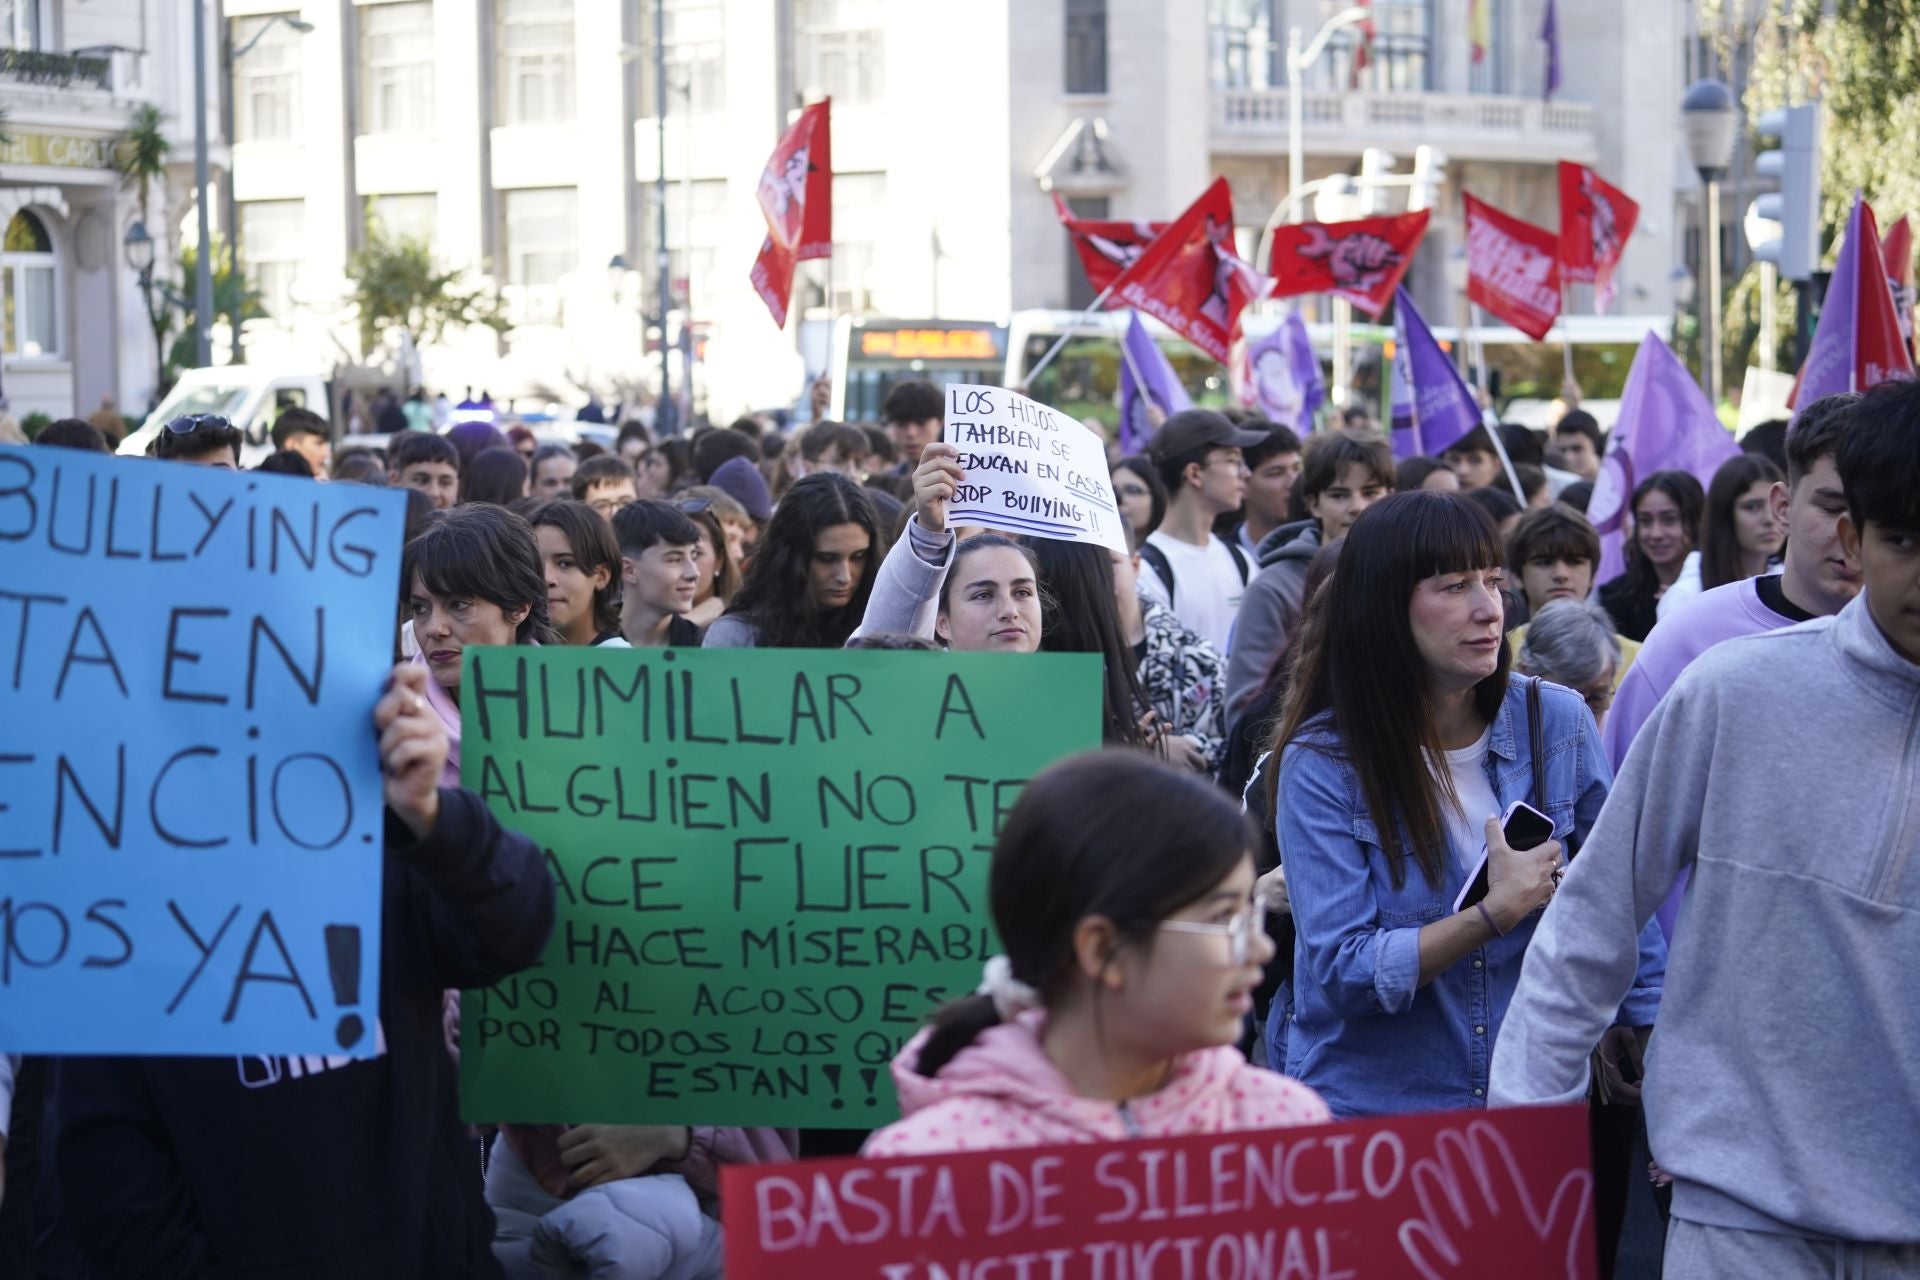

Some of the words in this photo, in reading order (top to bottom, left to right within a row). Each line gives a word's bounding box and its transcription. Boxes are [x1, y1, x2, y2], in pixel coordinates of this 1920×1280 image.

[952, 390, 995, 415] LOS
[956, 453, 1028, 474] EDUCAN
[1037, 463, 1059, 481] EN
[1068, 471, 1109, 497] CASA
[1051, 440, 1071, 461] SE
[951, 485, 992, 503] STOP
[163, 606, 324, 710] EN
[934, 673, 986, 741] A
[818, 769, 917, 829] NO
[543, 847, 683, 912] ACE
[566, 920, 723, 969] HACE
[165, 898, 365, 1050] YA!
[480, 976, 558, 1013] NO
[593, 979, 656, 1014] AL
[692, 983, 864, 1023] ACOSO
[478, 1017, 561, 1051] POR
[580, 1021, 731, 1057] TODOS
[751, 1026, 836, 1055] LOS
[754, 1164, 967, 1252] BASTA
[985, 1155, 1066, 1237] DE
[1094, 1130, 1406, 1225] SILENCIO
